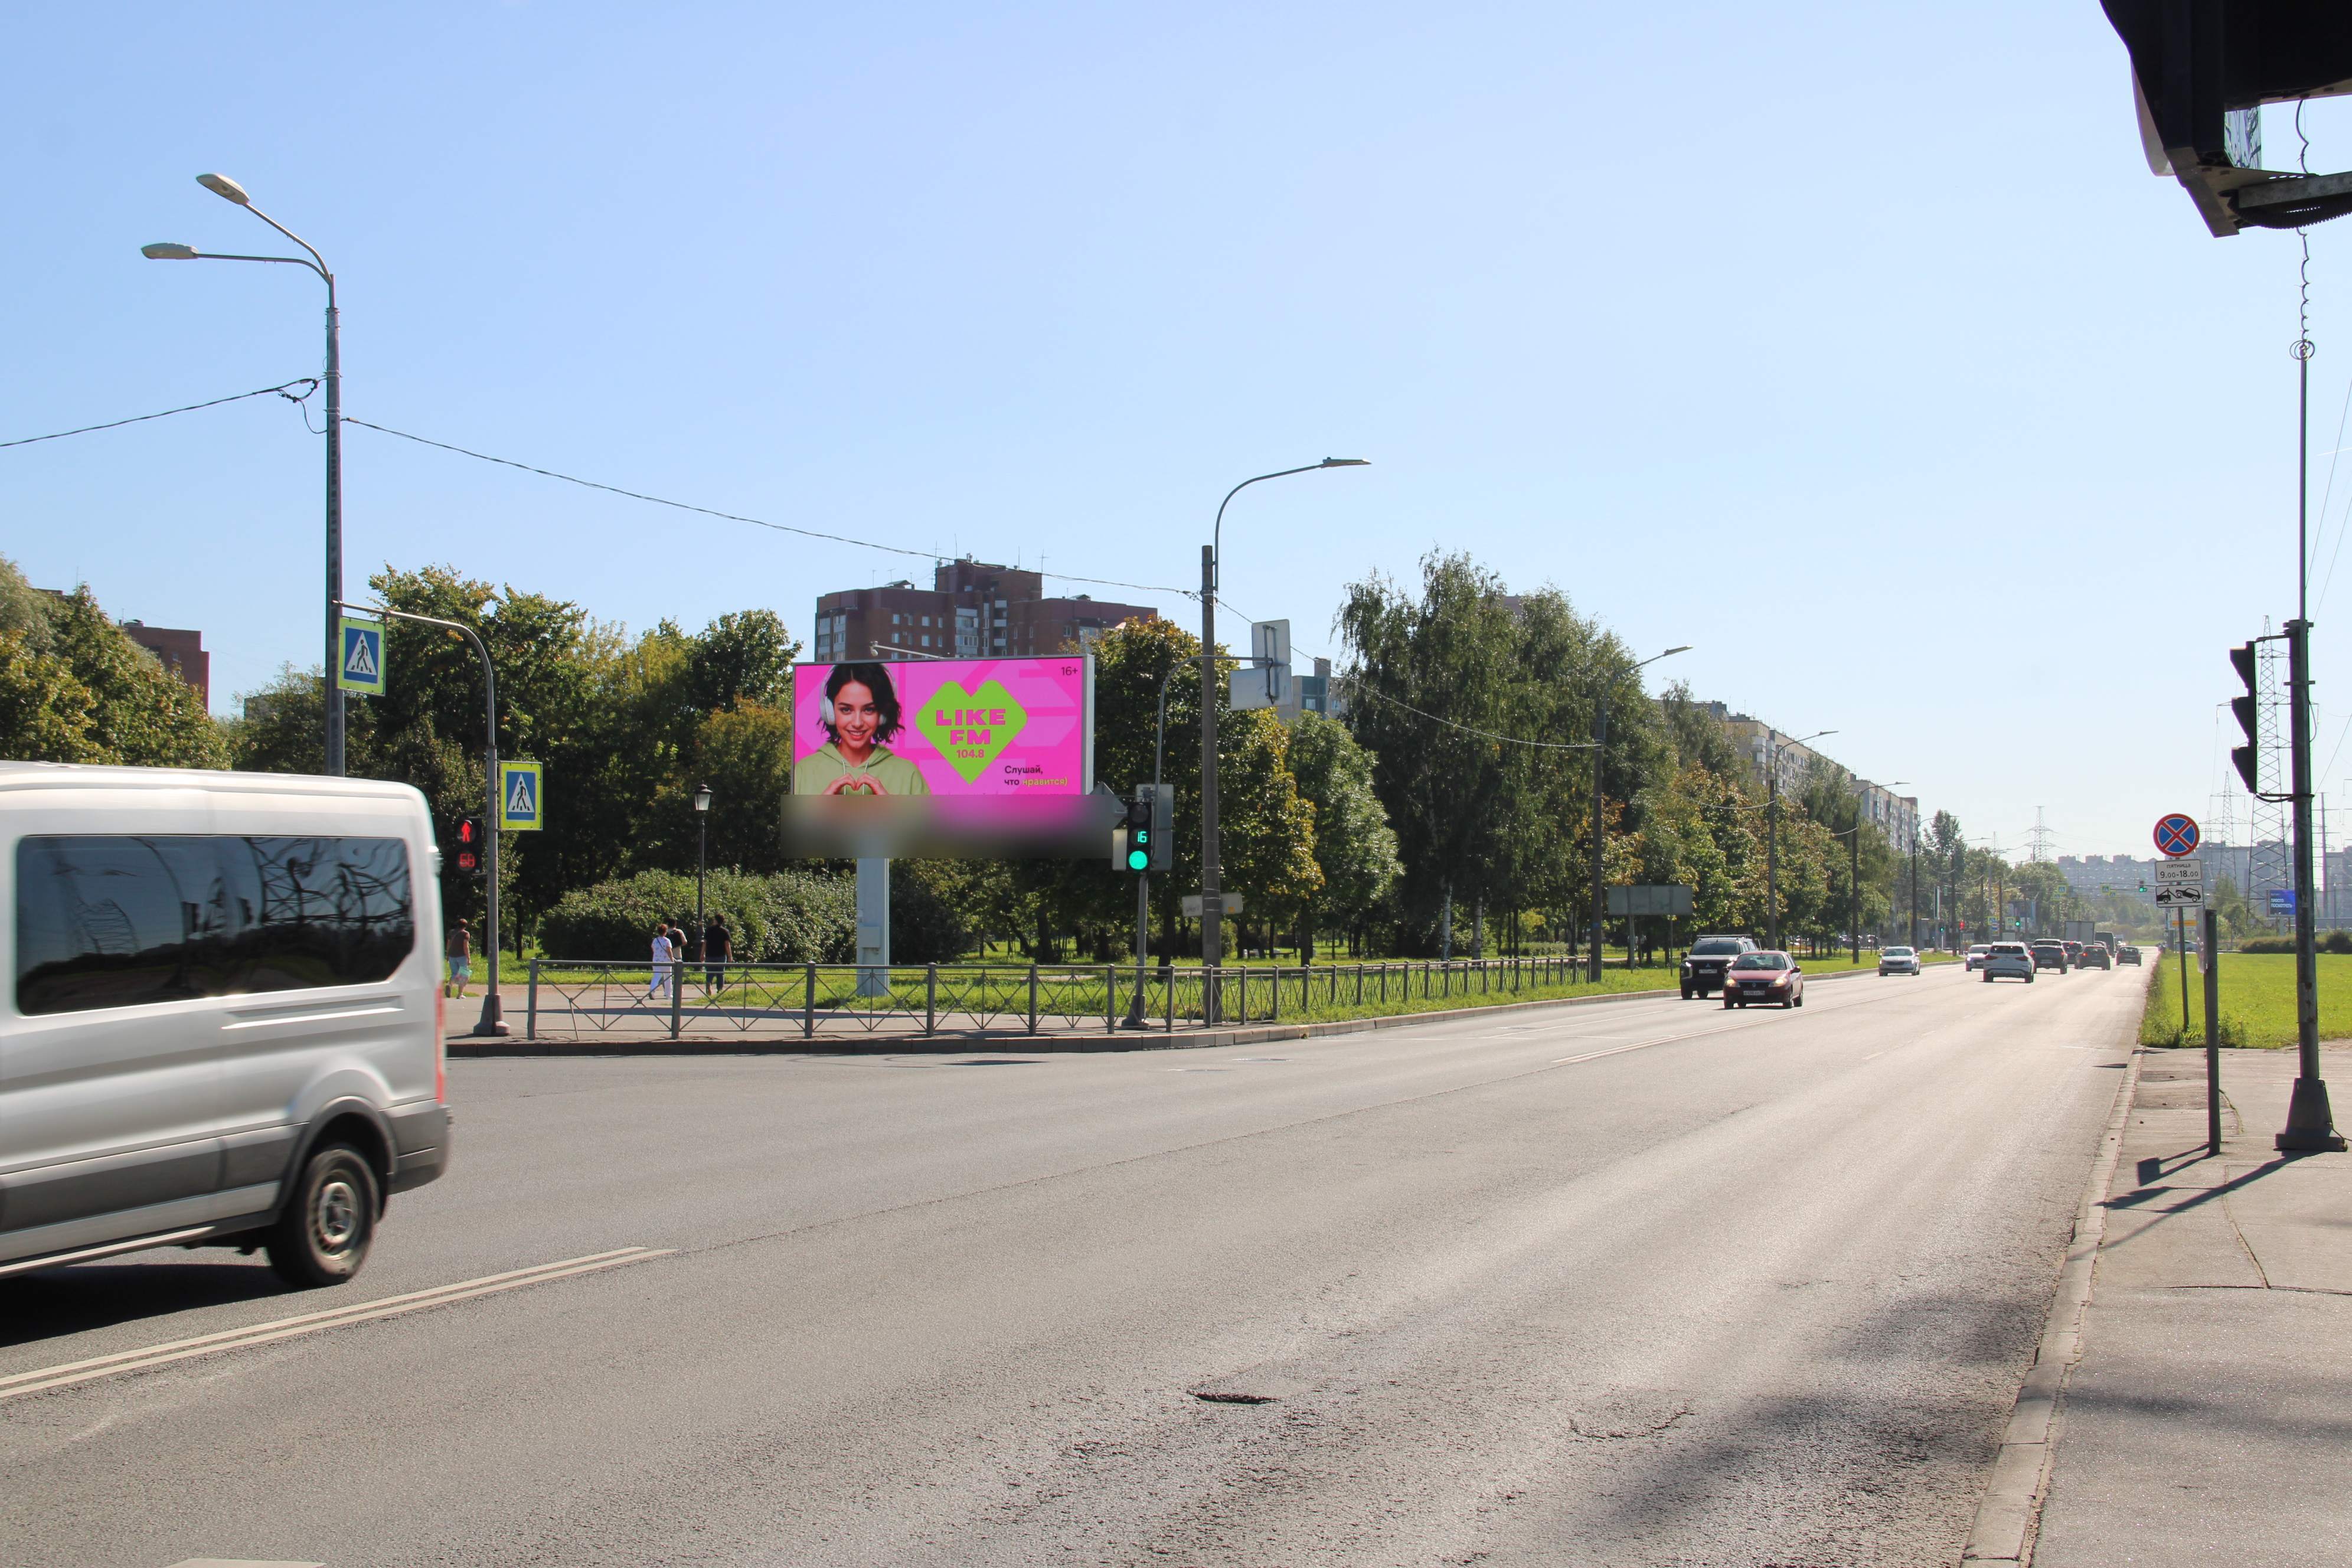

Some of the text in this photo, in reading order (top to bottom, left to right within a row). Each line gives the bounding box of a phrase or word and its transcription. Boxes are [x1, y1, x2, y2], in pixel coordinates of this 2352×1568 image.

[1061, 666, 1078, 676] 16+
[936, 708, 1006, 726] LIKE
[950, 729, 991, 745] FM
[956, 749, 985, 758] 104.8
[1004, 765, 1043, 775] Слушай,
[1022, 777, 1068, 788] нравится)
[1138, 831, 1147, 843] 16
[2160, 870, 2199, 878] 9.00-18.00
